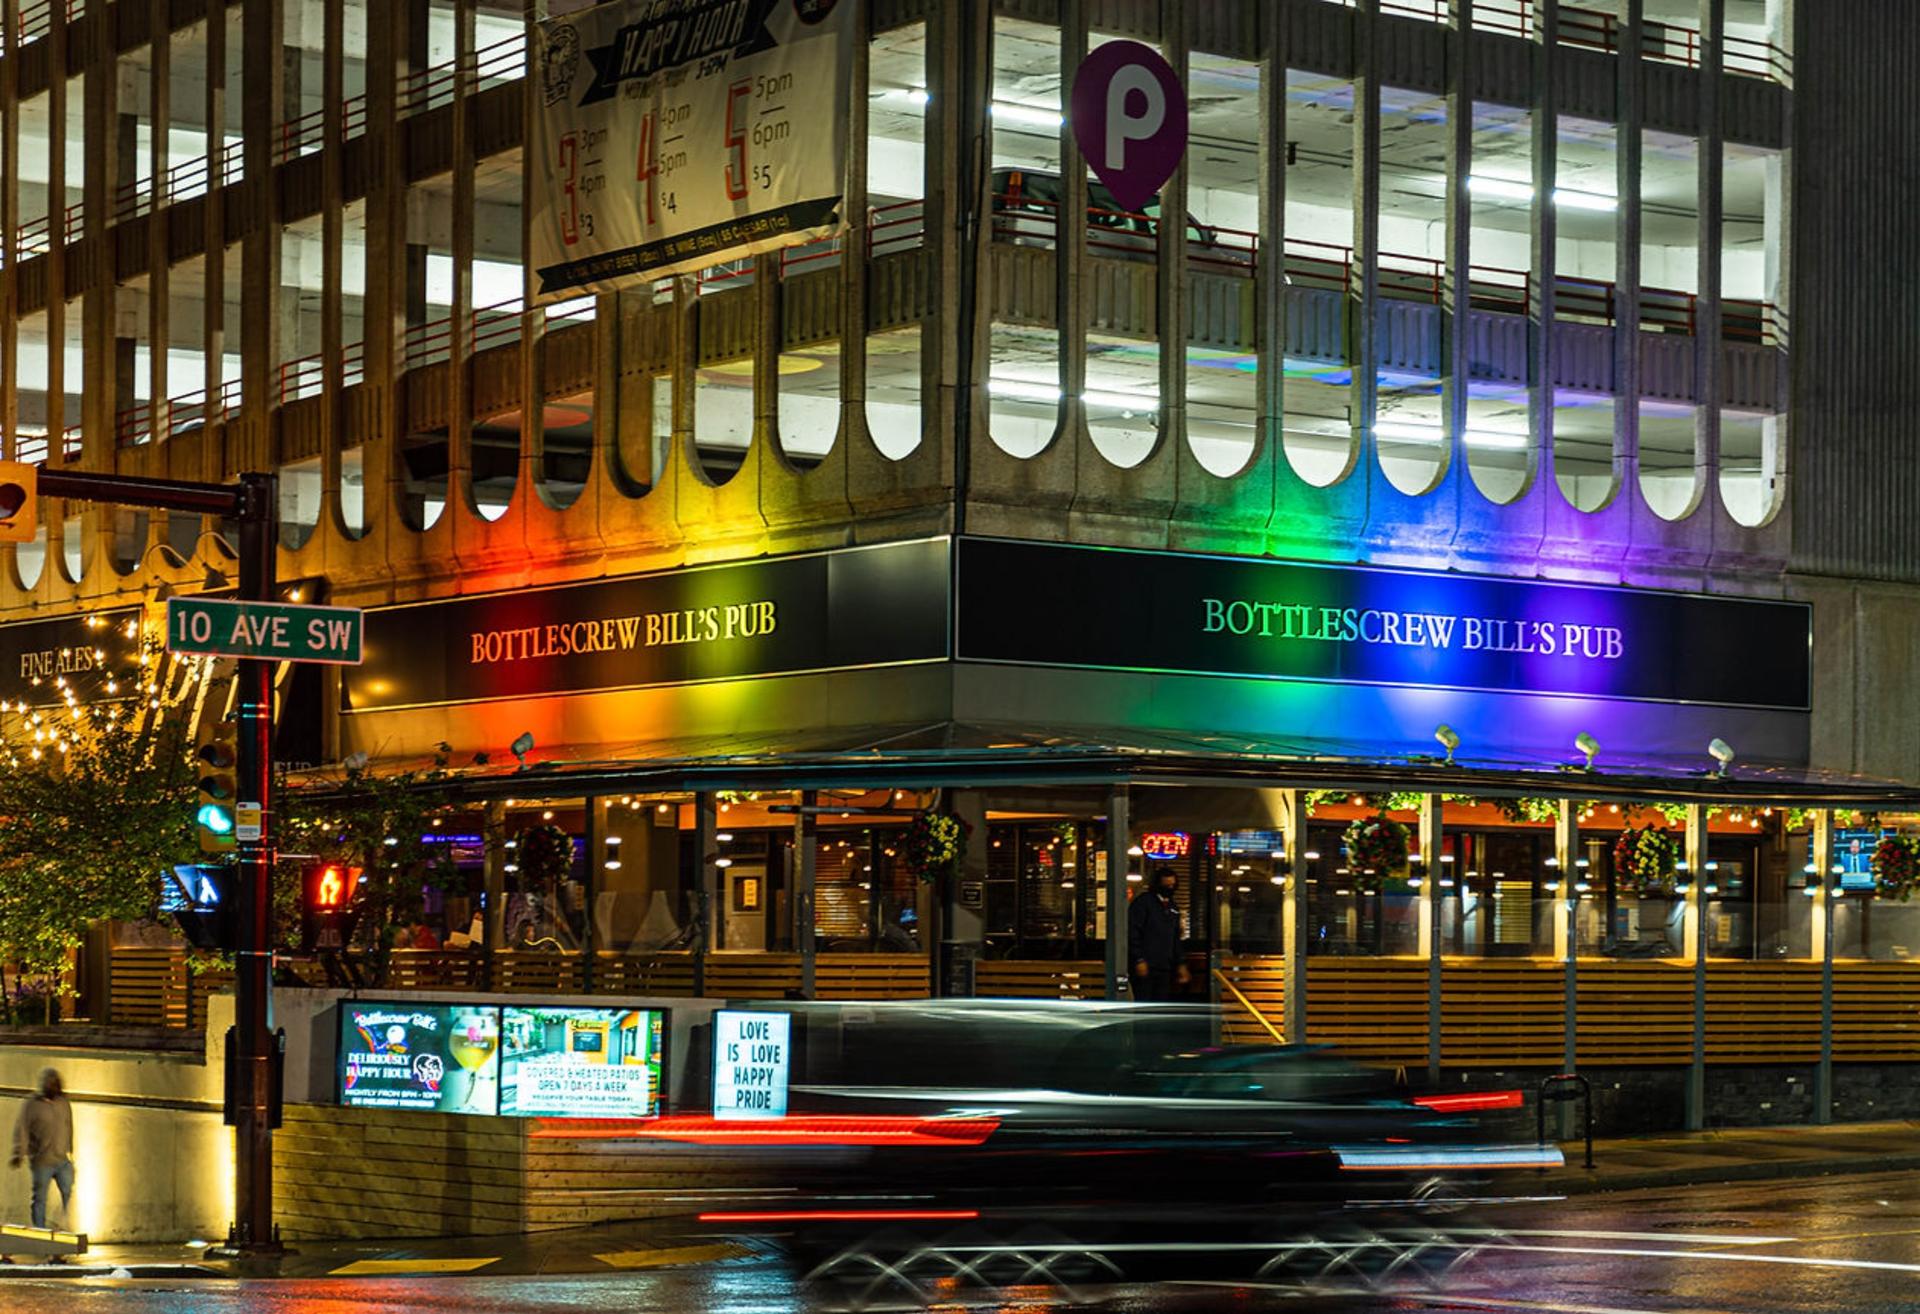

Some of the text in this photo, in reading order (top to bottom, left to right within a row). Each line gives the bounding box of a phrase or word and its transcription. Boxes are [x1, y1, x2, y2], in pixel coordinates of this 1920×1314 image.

[620, 15, 692, 75] HAPPY
[755, 72, 793, 101] 5pm
[661, 104, 691, 130] 4pm
[581, 128, 607, 152] 3pm
[753, 120, 790, 149] 6pm
[659, 151, 688, 178] 5pm
[579, 174, 606, 198] 4pm
[753, 164, 772, 190] $5
[661, 192, 677, 214] $4
[579, 213, 594, 237] $3
[178, 611, 352, 651] 10 AVE SW
[471, 601, 776, 663] BOTTLESCREW BILL'S PUB
[1202, 599, 1624, 659] BOTTLESCREW BILL'S PUB
[20, 646, 93, 678] FINE ALES
[1143, 834, 1188, 855] OPEN
[740, 1021, 769, 1040] LOVE
[728, 1043, 781, 1064] IS LOVE
[347, 1067, 411, 1079] HAPPY HOUR
[576, 1069, 608, 1080] HEATED
[610, 1070, 640, 1081] PATIOS
[733, 1066, 774, 1087] HAPPY
[538, 1080, 561, 1091] OPEN
[571, 1081, 593, 1092] DAYS
[603, 1082, 627, 1092] WEEK
[736, 1089, 771, 1109] PRIDE
